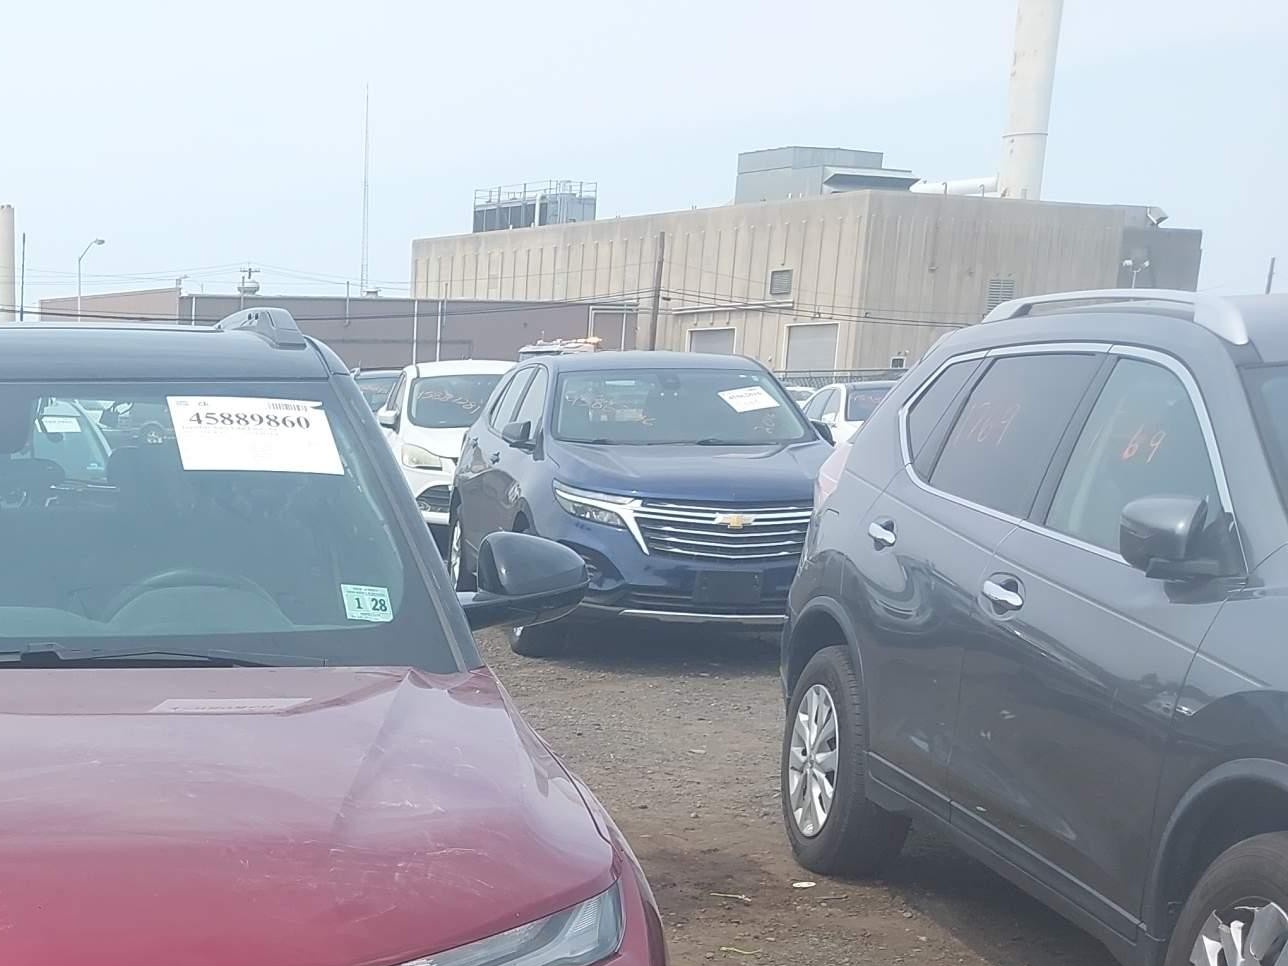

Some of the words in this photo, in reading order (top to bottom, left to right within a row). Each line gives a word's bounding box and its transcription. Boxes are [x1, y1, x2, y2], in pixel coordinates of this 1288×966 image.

[189, 411, 311, 430] 45889860
[355, 597, 363, 610] 1
[371, 597, 388, 612] 28
